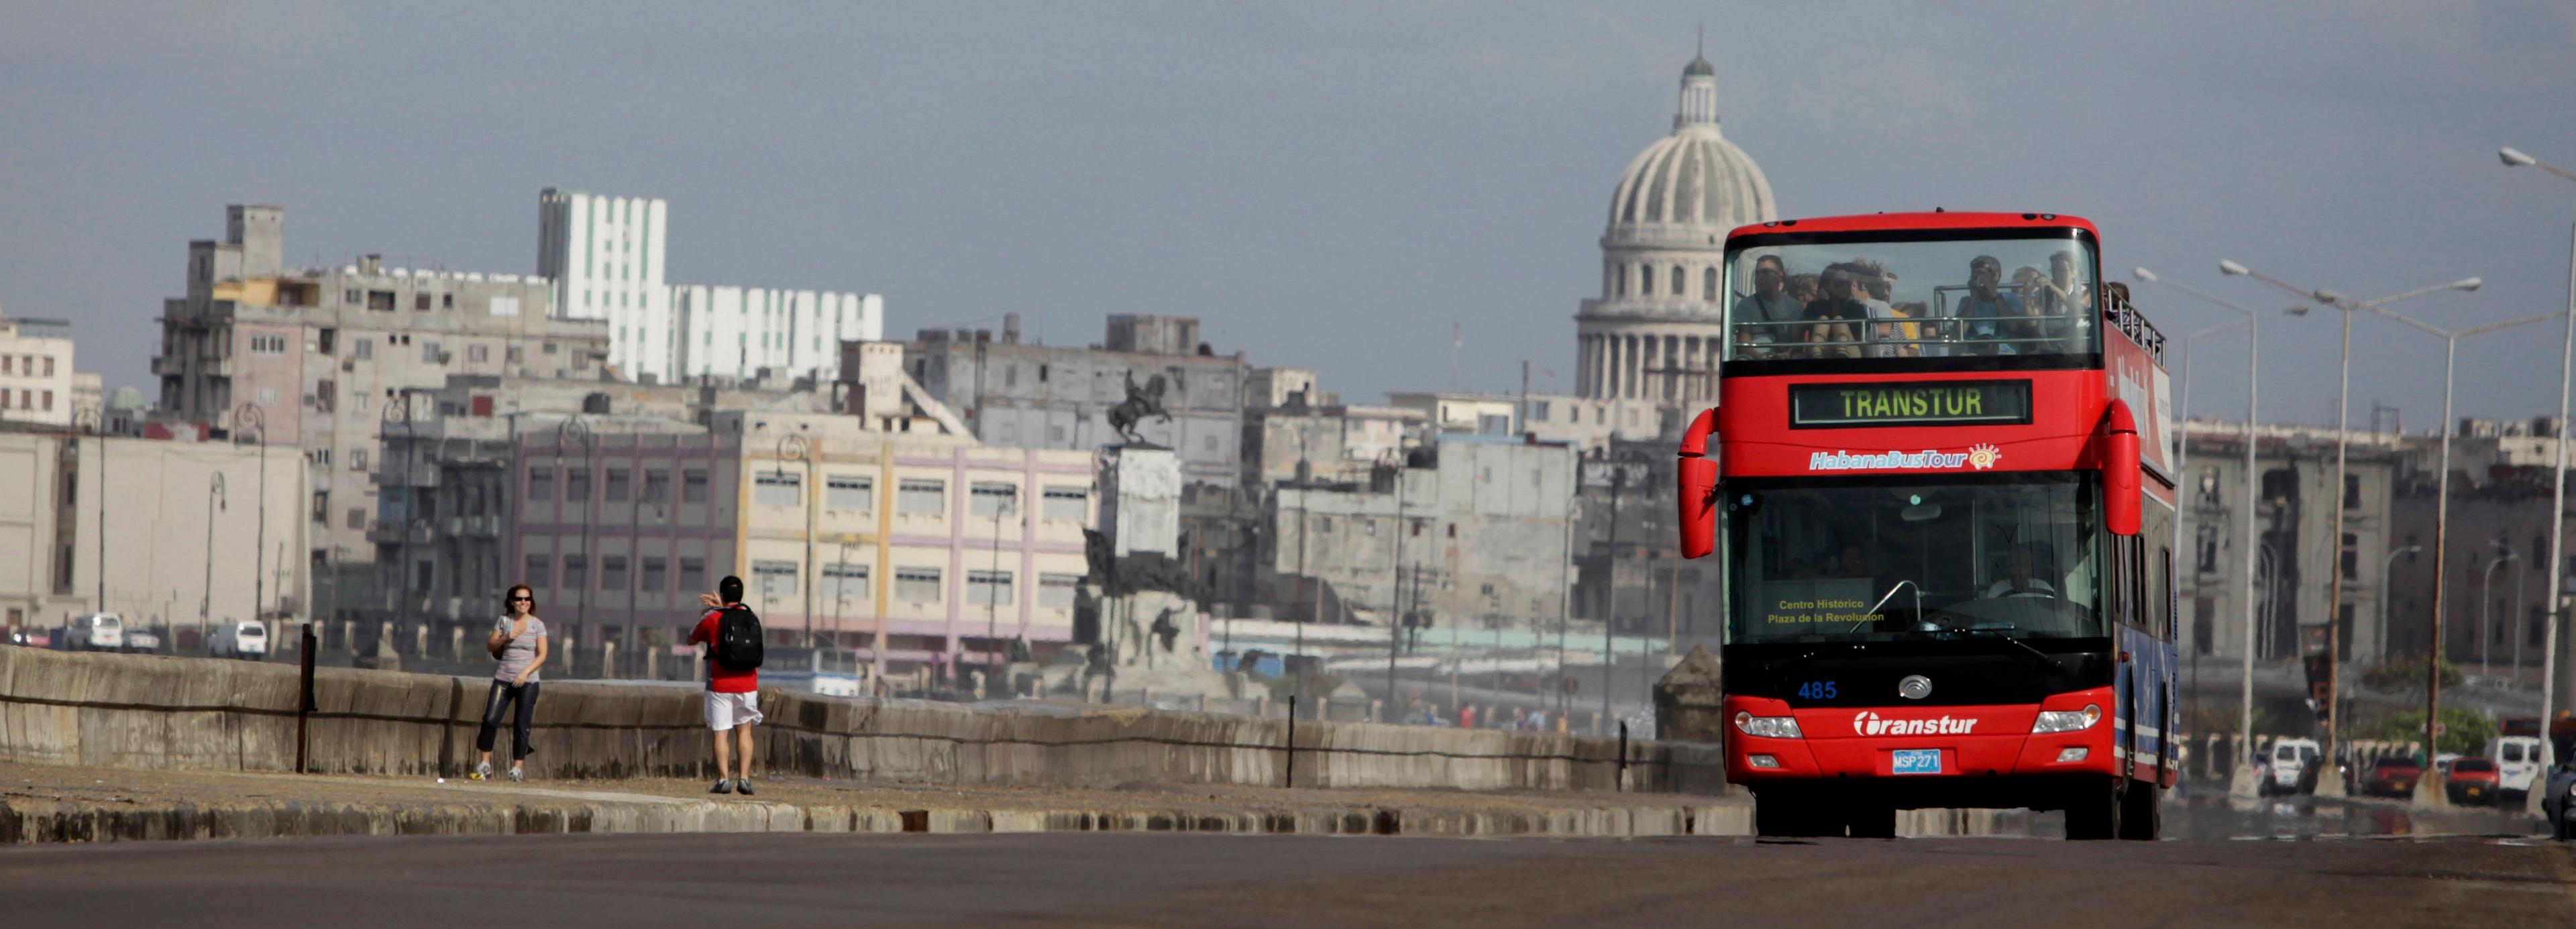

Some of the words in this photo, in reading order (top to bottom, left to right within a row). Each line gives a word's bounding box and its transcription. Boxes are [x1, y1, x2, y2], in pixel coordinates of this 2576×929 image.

[1840, 388, 1982, 418] TRANSTUR
[1809, 450, 1968, 470] HabanaBusTour
[1779, 600, 1815, 610] Centro
[1817, 599, 1864, 608] Histórico
[1768, 614, 1796, 624] Plaza
[1798, 613, 1811, 622] de
[1814, 613, 1823, 622] la
[1798, 681, 1837, 699] 485
[1917, 755, 1938, 767] 271
